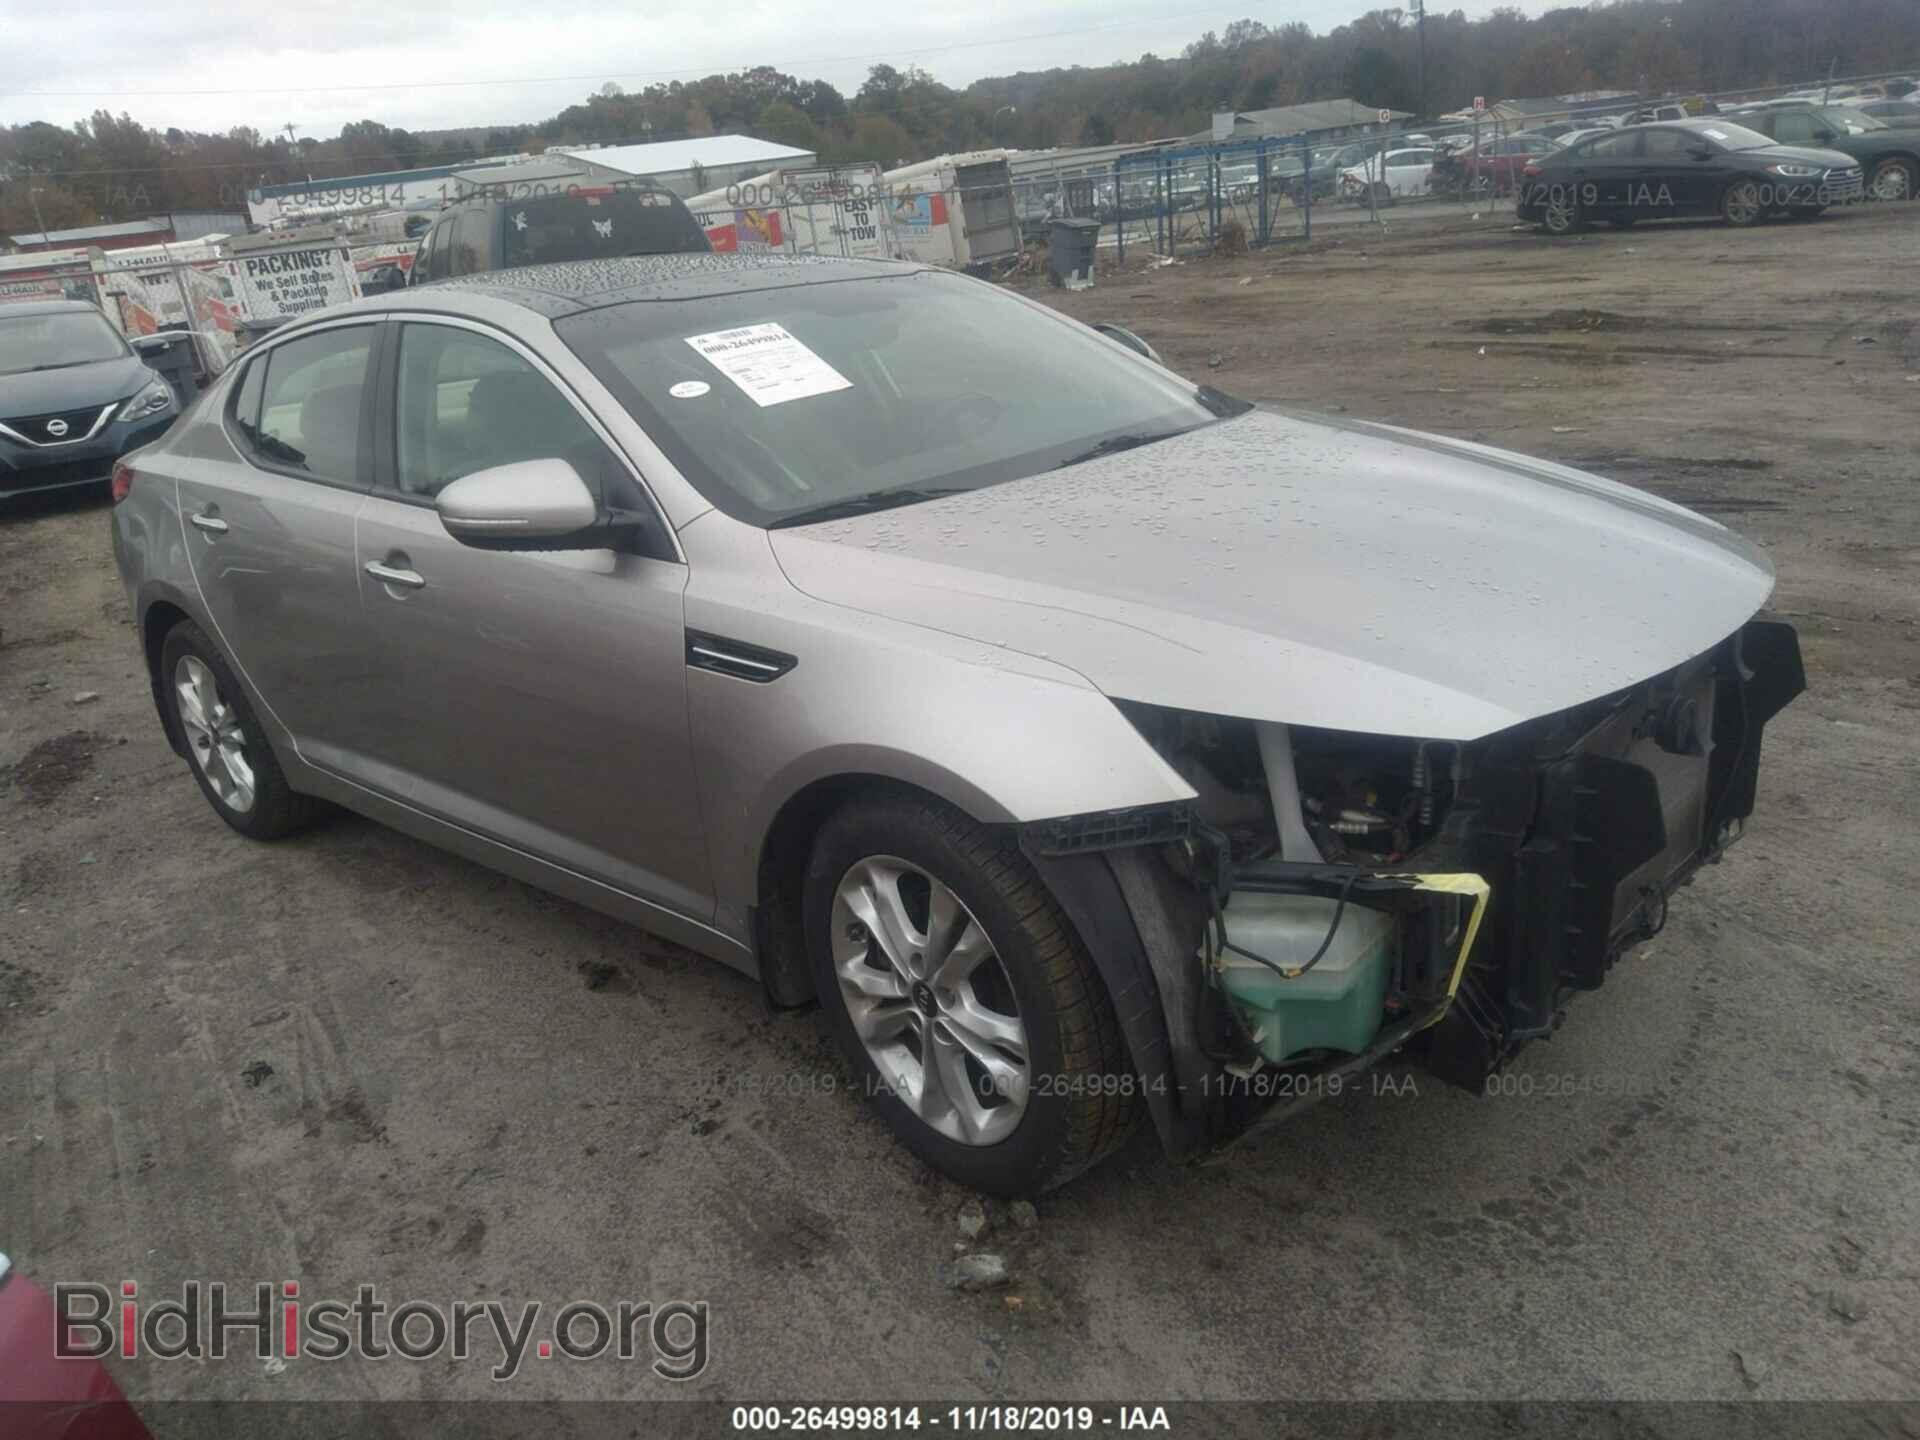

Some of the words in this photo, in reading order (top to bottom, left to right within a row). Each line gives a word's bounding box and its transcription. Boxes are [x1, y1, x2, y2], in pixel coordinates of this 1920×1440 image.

[844, 198, 875, 213] EASY
[852, 212, 869, 226] TO
[849, 225, 877, 241] TOW
[246, 249, 332, 277] PACKING?
[255, 278, 274, 292] We
[276, 275, 299, 289] Sell
[270, 291, 280, 303] &
[283, 285, 329, 300] Packing
[278, 297, 327, 314] Supplies
